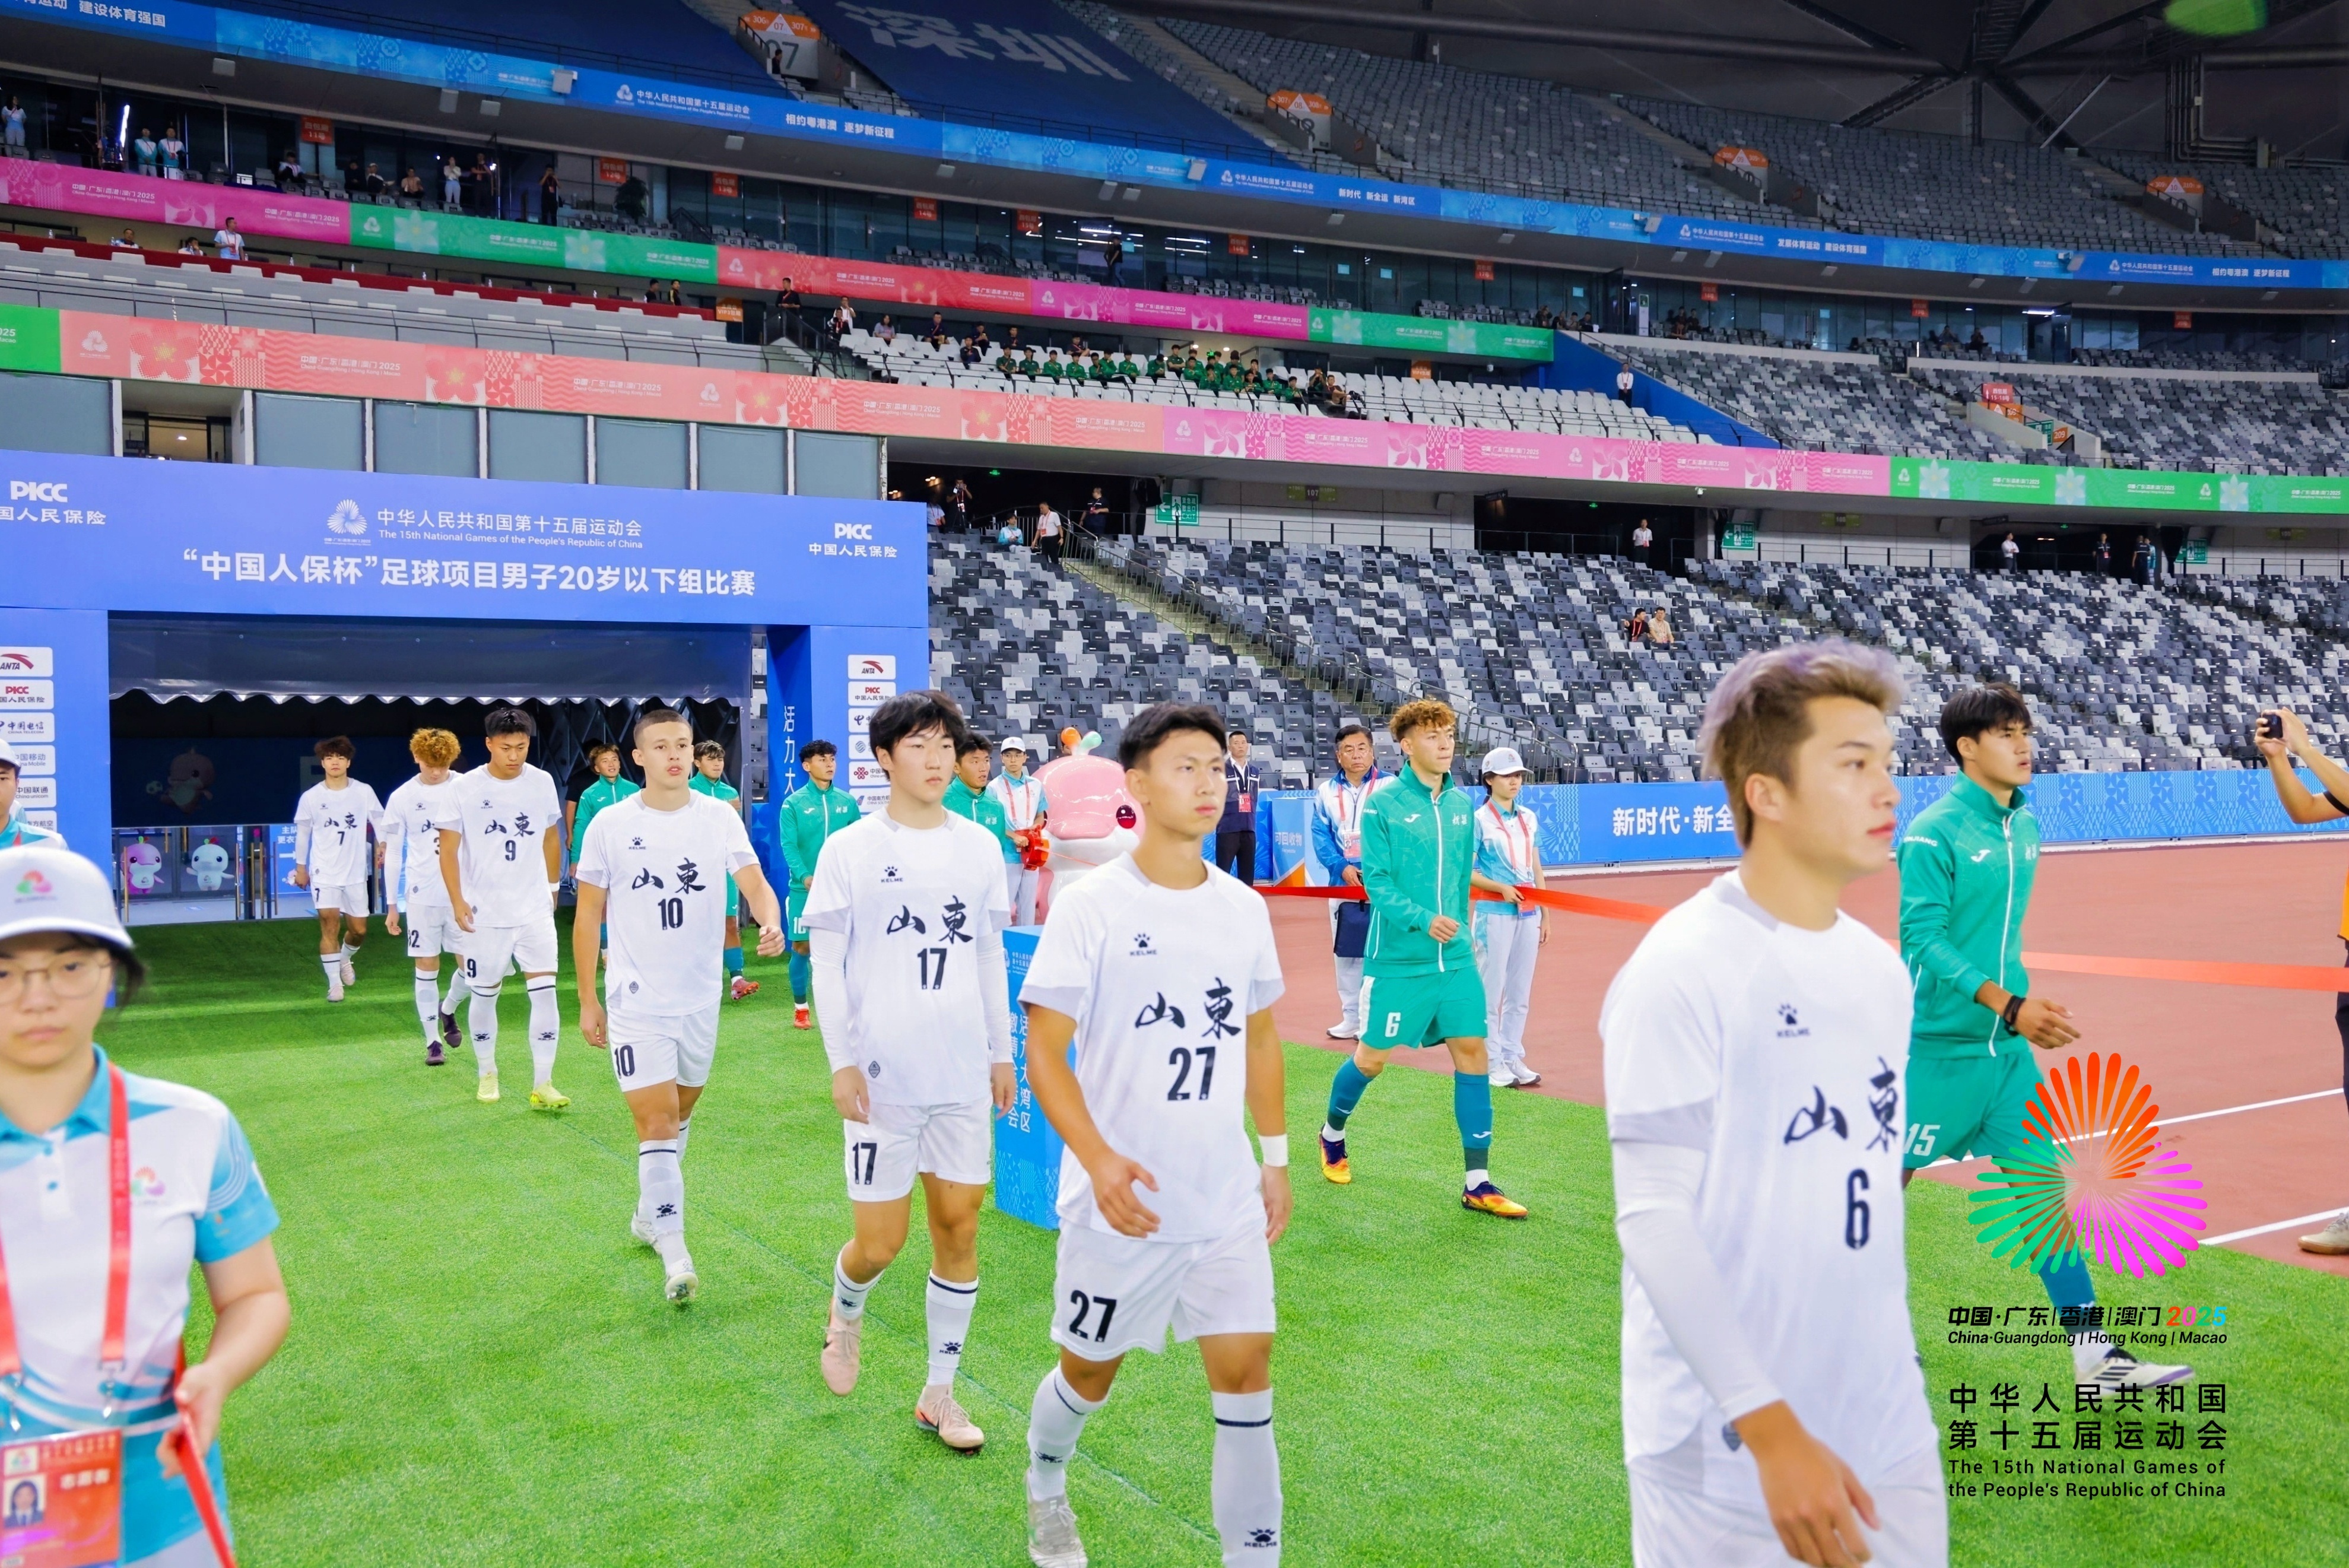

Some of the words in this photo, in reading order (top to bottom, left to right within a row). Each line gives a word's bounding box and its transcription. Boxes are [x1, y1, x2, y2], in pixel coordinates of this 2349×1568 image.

[79, 0, 166, 27] 建设体育强国
[637, 90, 750, 114] 中华人民共和国第十五届运动会
[786, 113, 837, 132] 相约粤港澳
[844, 121, 894, 139] 逐梦新征程
[137, 191, 155, 200] 2025
[1339, 188, 1361, 199] 新时代
[1366, 191, 1388, 202] 新全运
[1393, 194, 1415, 206] 新湾区
[323, 214, 340, 223] 2025
[379, 361, 401, 370] 2025
[642, 383, 661, 392] 2025
[2053, 431, 2065, 439] 209
[10, 481, 68, 503] PICC
[1307, 488, 1319, 497] 107
[0, 506, 107, 525] 国人民保险
[377, 508, 642, 537] 中华人民共和国第十五届运动会
[379, 529, 396, 539] The
[399, 530, 421, 539] 15th
[424, 531, 463, 541] National
[465, 534, 497, 543] Games
[500, 534, 509, 543] of
[512, 535, 526, 544] the
[528, 536, 565, 550] People's
[567, 538, 605, 548] Republic
[607, 539, 617, 548] of
[618, 540, 643, 549] China
[834, 522, 872, 540] PICC
[809, 542, 897, 558] 中国人民保险
[183, 548, 756, 598] “中国人保杯”足球项目男子20岁以下组比赛
[8, 721, 44, 731] 中国电信
[1612, 804, 1734, 837] 新时代·新全
[337, 831, 345, 846] 7
[1274, 831, 1302, 847] 可回收物
[504, 840, 516, 861] 9
[314, 888, 320, 902] 7
[658, 897, 683, 931] 10
[466, 958, 477, 978] 9
[917, 948, 947, 990] 17
[1385, 1012, 1401, 1037] 6
[1777, 1029, 1810, 1037] KELME
[614, 1045, 635, 1079] 10
[1167, 1046, 1216, 1101] 27
[1903, 1123, 1940, 1156] 15
[852, 1142, 877, 1185] 17
[1845, 1169, 1869, 1249] 6
[1069, 1289, 1117, 1343] 27
